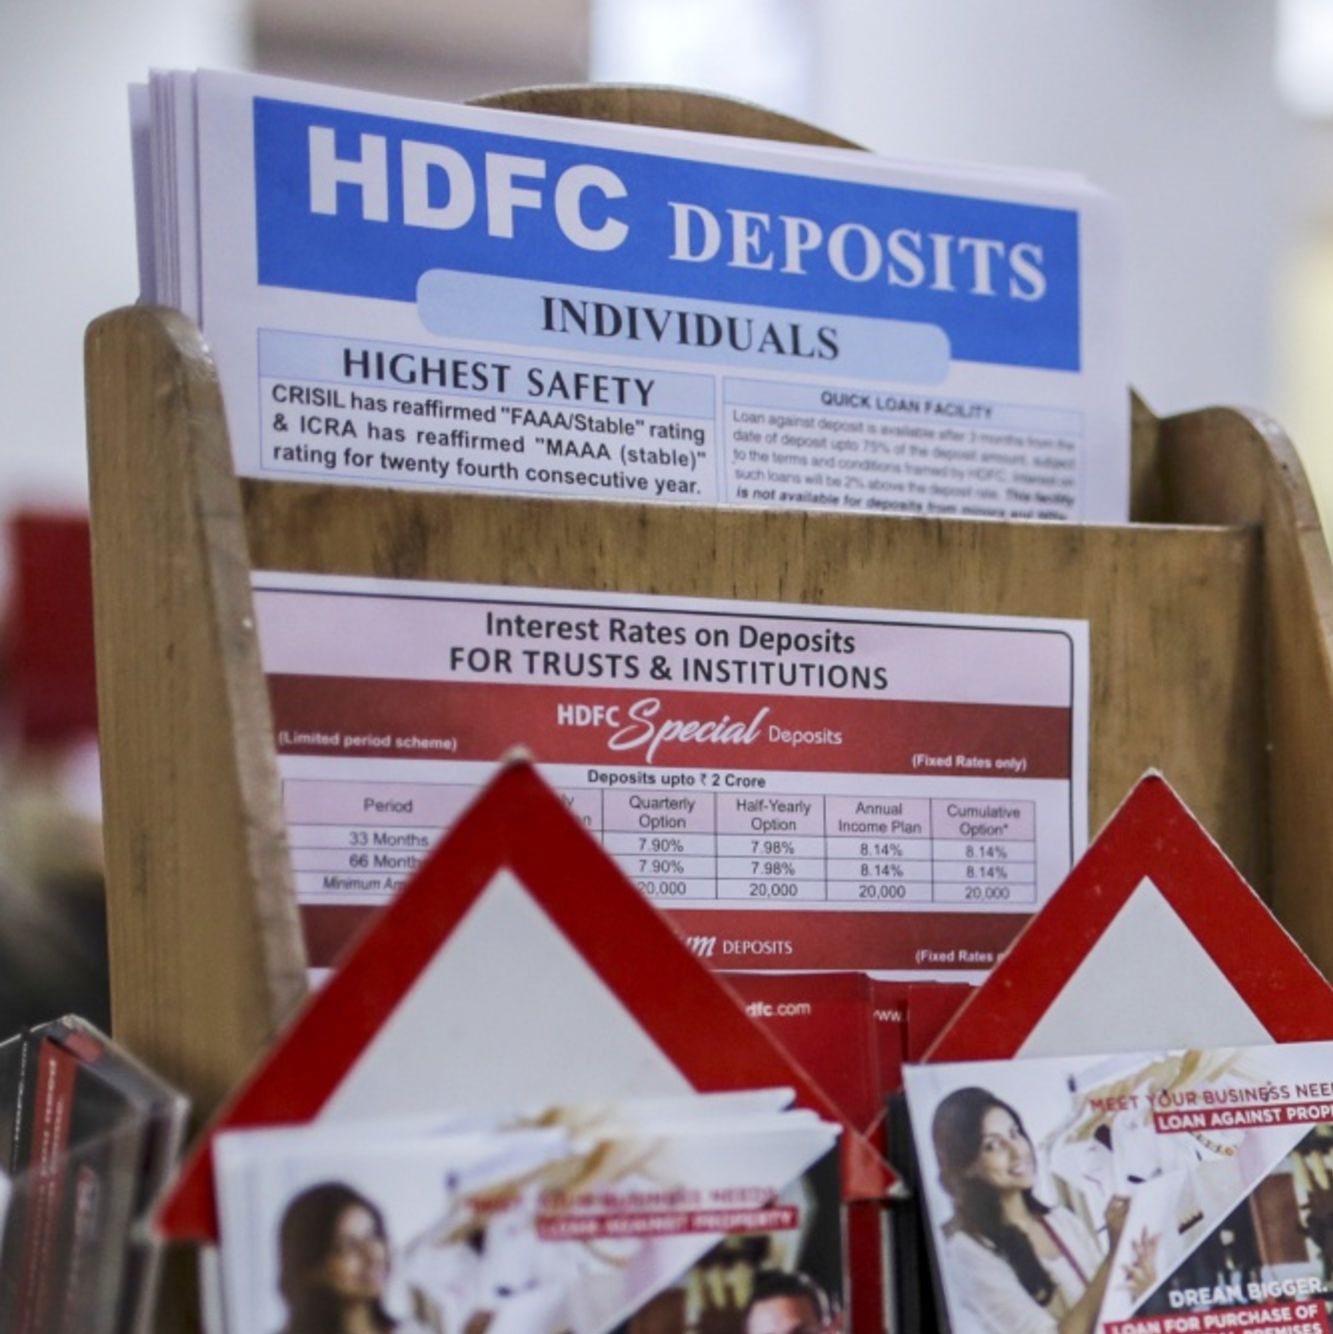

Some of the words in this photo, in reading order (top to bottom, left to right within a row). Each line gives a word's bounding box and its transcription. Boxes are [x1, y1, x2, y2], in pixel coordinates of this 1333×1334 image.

[308, 125, 630, 252] HDFC
[668, 200, 1047, 302] DEPOSITS
[541, 296, 840, 361] INDIVIDUALS
[343, 347, 512, 394] HIGHEST
[527, 368, 656, 407] SAFETY
[820, 390, 871, 410] QUICK
[876, 396, 921, 414] LOAN
[924, 401, 992, 420] FACILITY
[271, 384, 345, 408] CRISIL
[351, 392, 388, 412] has
[393, 398, 496, 423] reaffirmed
[501, 406, 645, 437] "FAAA/Stable"
[650, 422, 706, 446] rating
[733, 409, 766, 424] Loan
[768, 414, 815, 429] against
[817, 418, 864, 434] deposit
[272, 412, 289, 432] &
[300, 415, 358, 438] ICRA
[367, 422, 406, 443] has
[416, 430, 525, 453] reaffirmed
[535, 437, 613, 461] "MAAA
[620, 445, 706, 471] (stable)"
[733, 429, 762, 443] date
[765, 431, 778, 444] of
[780, 434, 828, 450] deposit
[748, 450, 770, 463] the
[273, 445, 338, 469] rating
[344, 448, 374, 469] for
[380, 454, 449, 479] twenty
[456, 458, 519, 481] fourth
[525, 466, 649, 491] consecutive
[655, 479, 701, 497] year.
[736, 486, 749, 499] is
[752, 488, 776, 501] not
[486, 611, 600, 641] Interest
[608, 617, 687, 646] Rates
[694, 624, 730, 648] on
[738, 624, 856, 656] Deposits
[450, 646, 513, 675] FOR
[522, 649, 641, 679] TRUSTS
[649, 654, 673, 681] &
[682, 656, 889, 691] INSTITUTIONS
[557, 703, 621, 728] HDFC
[607, 696, 770, 764] Special
[768, 724, 843, 747] Deposits
[278, 731, 340, 746] (Limited
[343, 733, 392, 748] period
[395, 736, 458, 751] scheme)
[911, 753, 953, 769] (Fixed
[955, 755, 993, 770] Rates
[994, 757, 1028, 772] only)
[587, 768, 657, 786] Deposits
[661, 773, 696, 789] upto
[711, 774, 721, 788] 2
[724, 774, 767, 789] Crore
[363, 797, 414, 814] Period
[628, 795, 697, 814] Quarterly
[736, 799, 812, 817] Half-Yearly
[855, 801, 903, 816] Annual
[946, 803, 1021, 819] Cumulative
[639, 814, 688, 831] Option
[751, 817, 797, 834] Option
[838, 819, 888, 834] Income
[891, 820, 922, 834] Plan
[349, 831, 369, 846] 33
[372, 832, 429, 847] Months
[638, 837, 685, 853] 7.90%
[751, 840, 796, 855] 7.98%
[859, 843, 904, 857] 8.14%
[349, 853, 369, 868] 66
[638, 859, 685, 874] 7.90%
[751, 861, 796, 876] 7.98%
[860, 863, 904, 877] 8.14%
[322, 876, 381, 891] Minimum
[749, 883, 799, 899] 20,000
[858, 884, 907, 900] 20,000
[722, 940, 793, 956] DEPOSITS
[915, 949, 955, 965] (Fixed
[957, 950, 994, 964] Rates
[1090, 1094, 1140, 1113] MEET
[1145, 1090, 1198, 1110] YOUR
[1203, 1083, 1291, 1106] BUSINESS
[1157, 1112, 1206, 1131] LOAN
[1211, 1108, 1282, 1127] AGAINST
[1168, 1284, 1244, 1309] DREAM
[1246, 1277, 1328, 1299] BIGGER.
[1164, 1317, 1201, 1334] FOR
[1204, 1308, 1293, 1328] PURCHASE
[1295, 1305, 1319, 1320] OF
